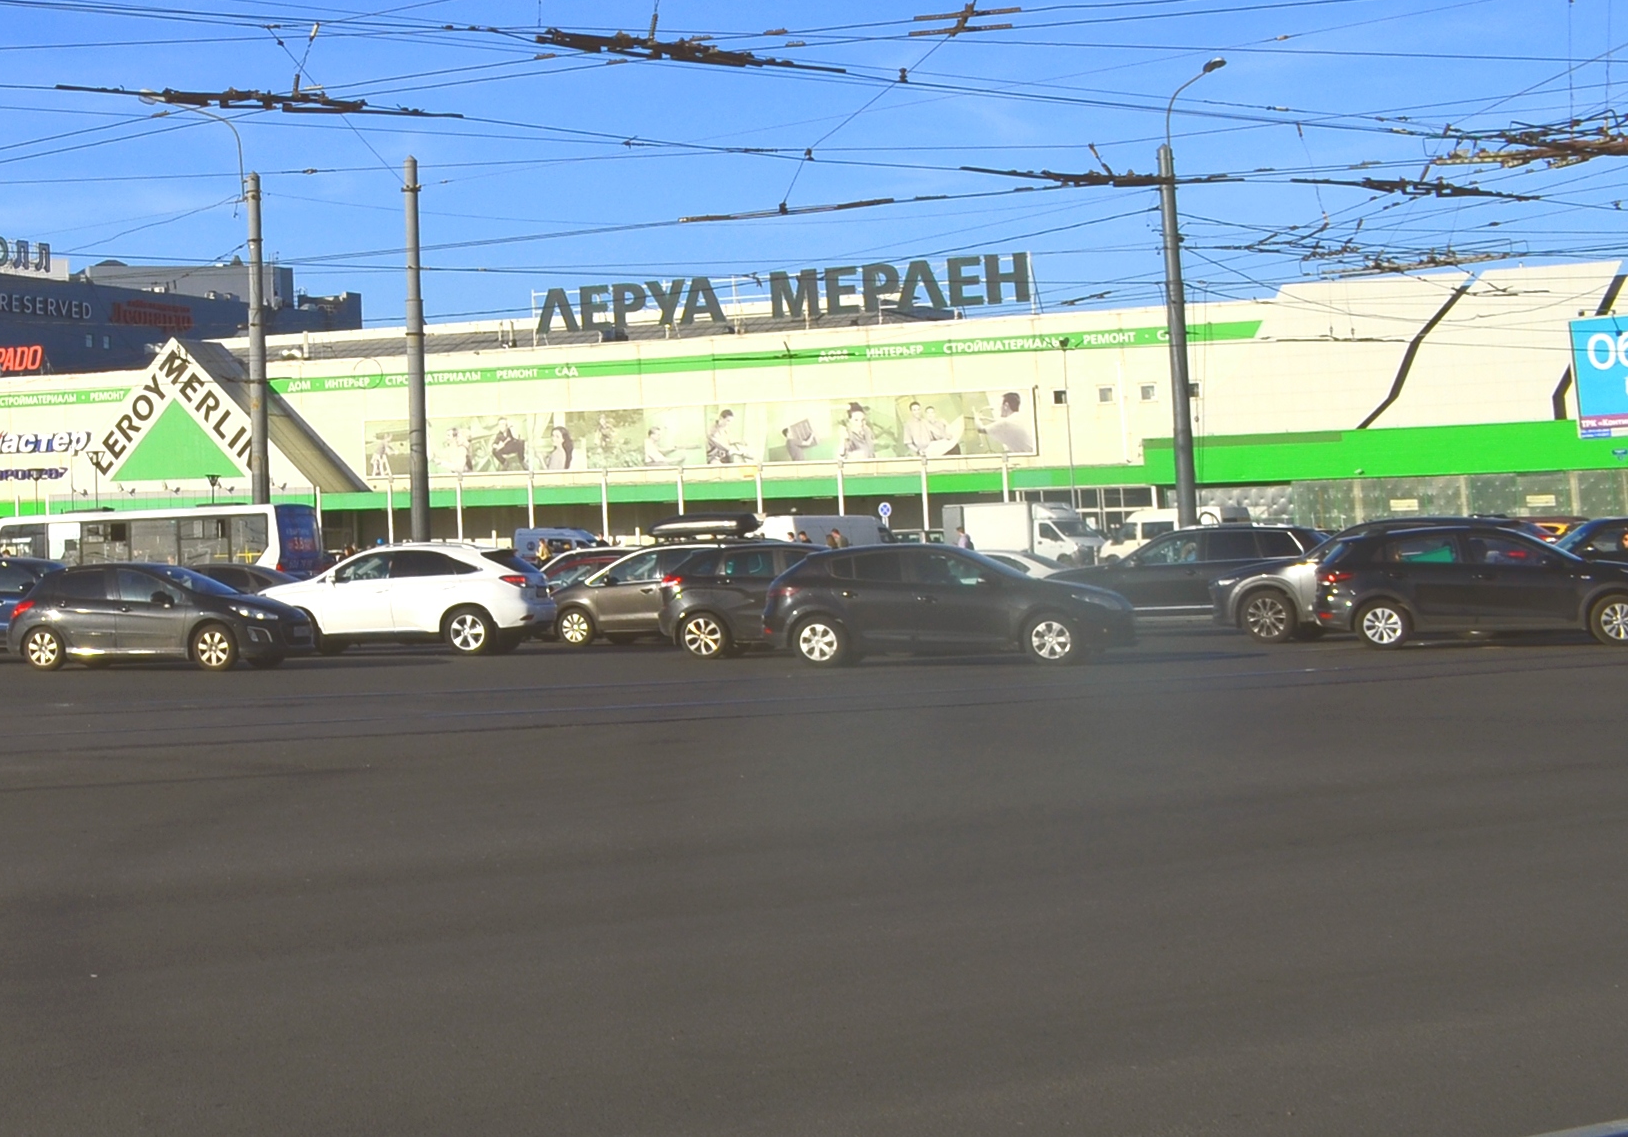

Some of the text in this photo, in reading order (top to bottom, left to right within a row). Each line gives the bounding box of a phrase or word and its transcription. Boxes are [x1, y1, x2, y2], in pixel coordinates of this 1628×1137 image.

[536, 251, 1032, 334] ЛЕРУА МЕРЛЕН
[865, 345, 924, 359] ИНТЕРЬЕР
[1083, 331, 1136, 345] РЕМОНТ
[287, 366, 579, 393] ДОМ ИНТЕРЬЕР СТРОАТЕРИАЛЫ РЕМОНТ САД
[0, 394, 77, 406] СТРОЙМАТЕРИАЛЫ
[90, 390, 125, 401] РЕМОНТ
[96, 373, 166, 476] LEROY
